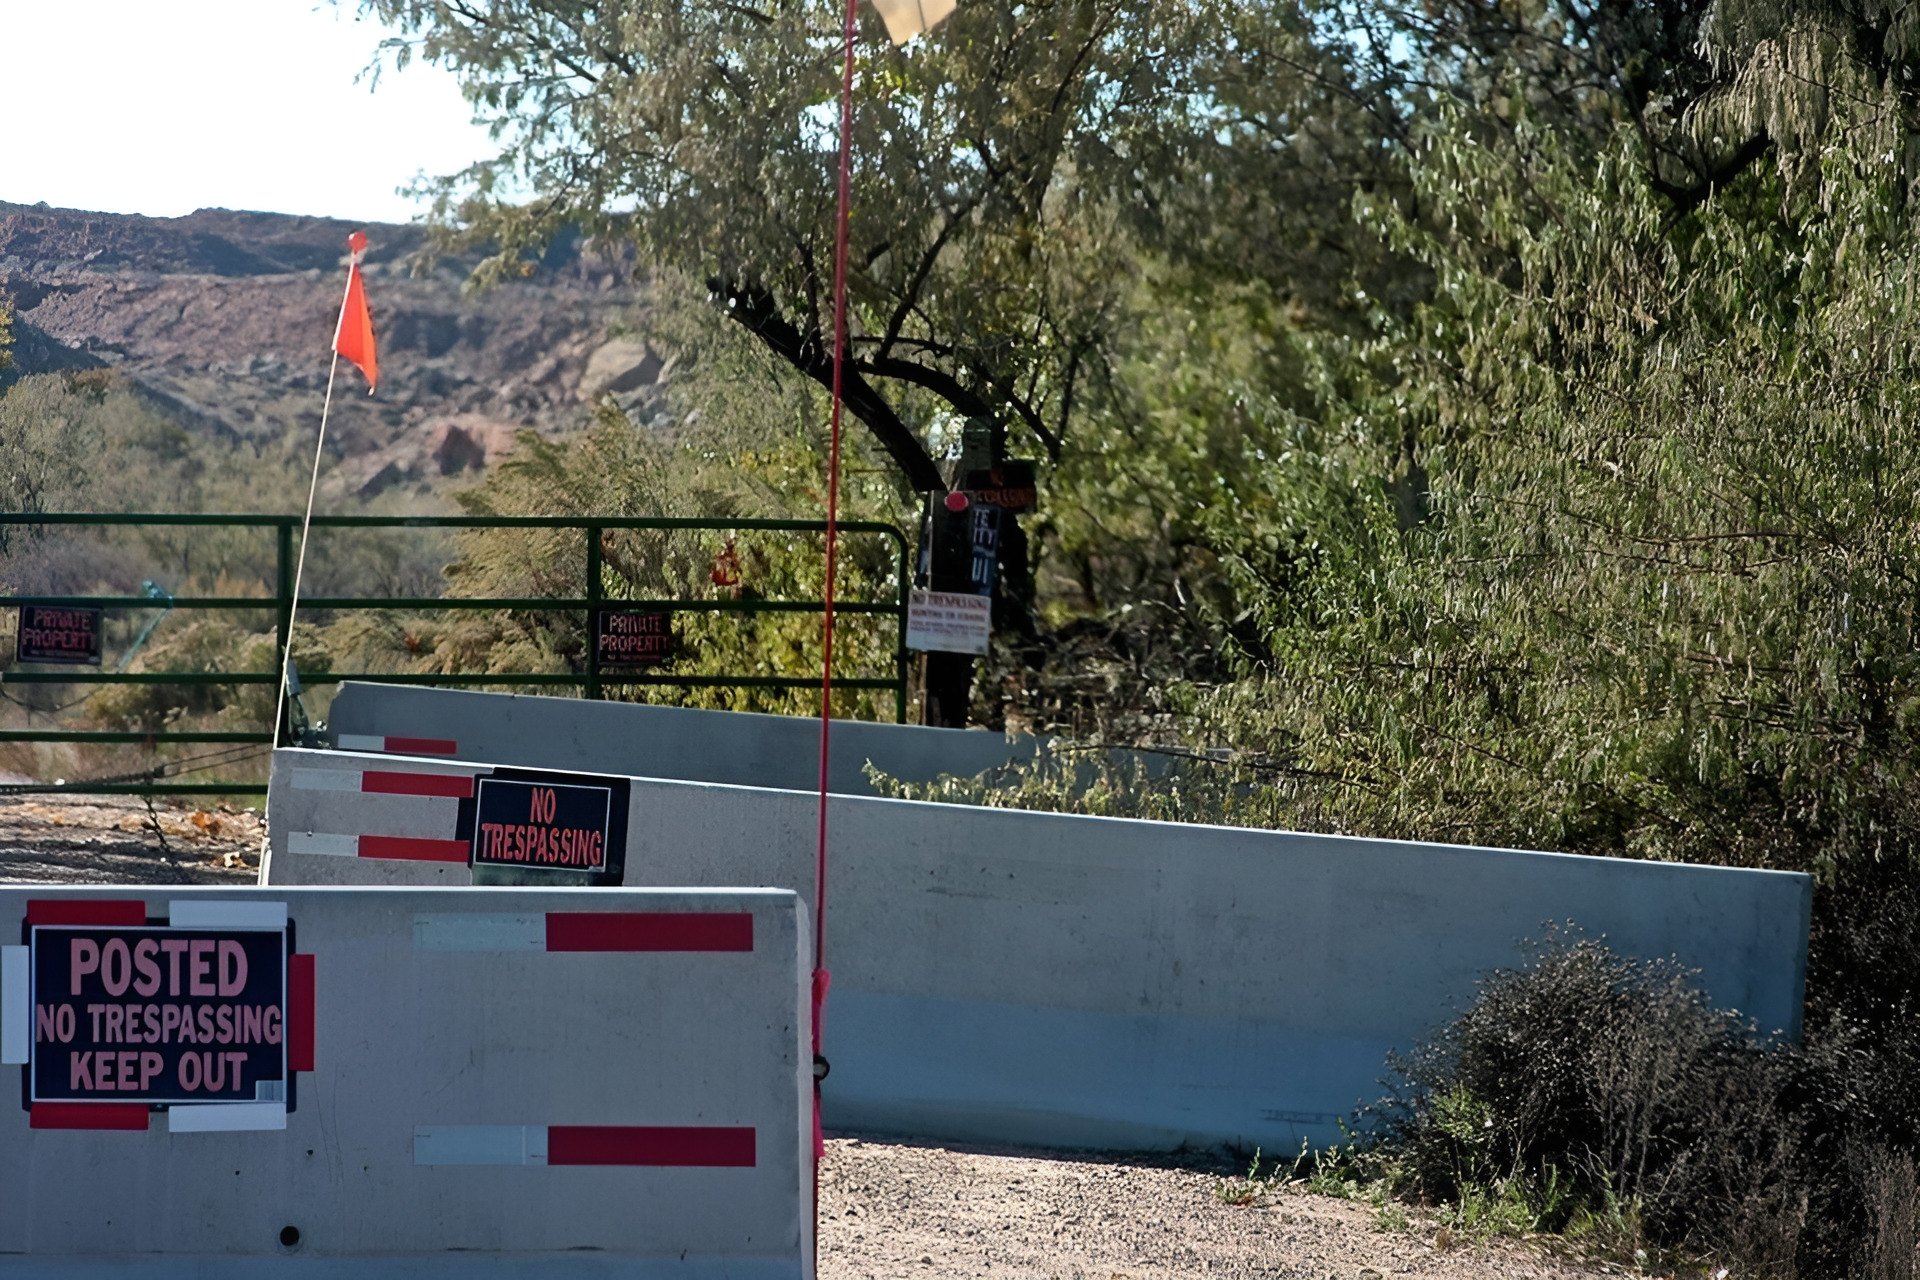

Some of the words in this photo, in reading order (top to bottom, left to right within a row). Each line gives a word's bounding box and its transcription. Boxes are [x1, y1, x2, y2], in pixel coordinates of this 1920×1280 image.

[599, 634, 669, 652] PROPERTY
[609, 614, 662, 633] PRIVATE
[529, 787, 556, 824] NO
[481, 823, 602, 865] TRESPASSING
[70, 937, 249, 997] POSTED
[36, 1004, 76, 1043] NO
[87, 1004, 282, 1045] TRESPASSING
[70, 1051, 164, 1091] KEEP
[178, 1051, 249, 1092] OUT
